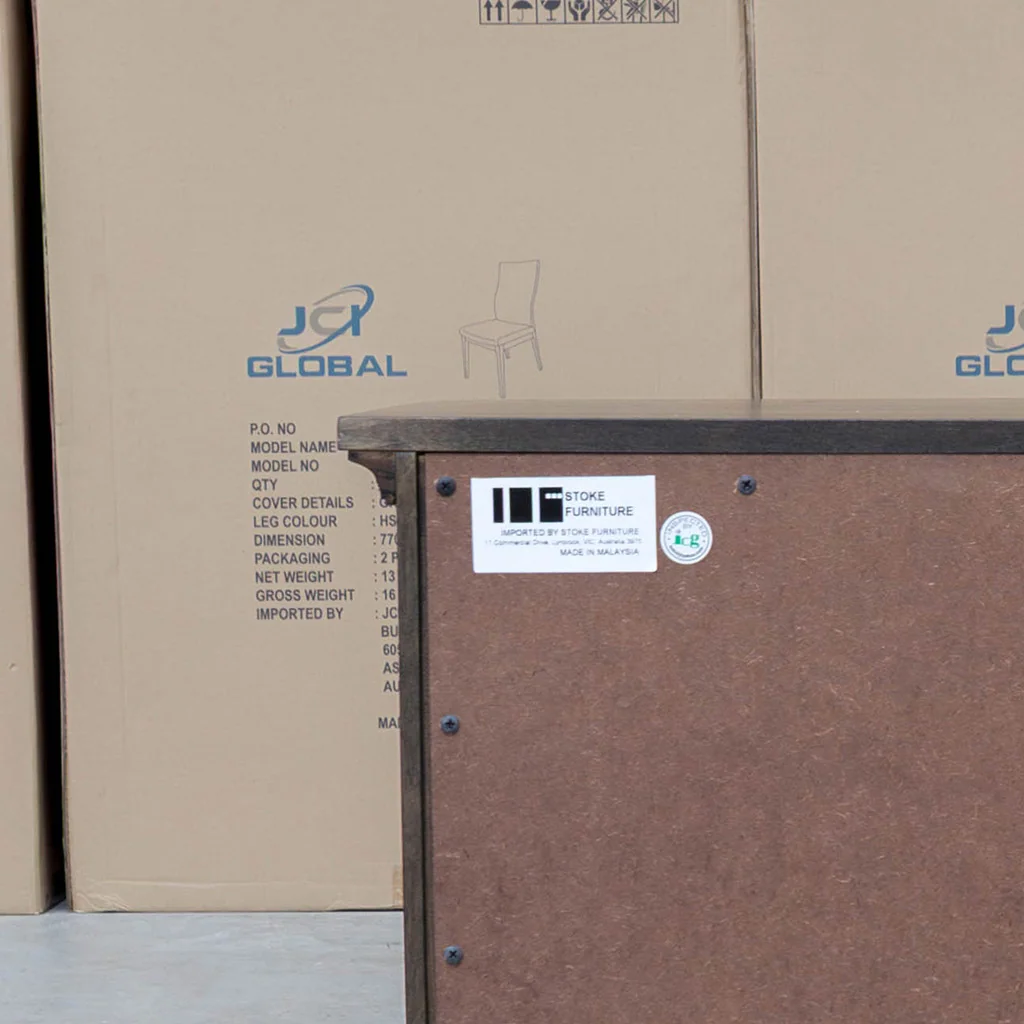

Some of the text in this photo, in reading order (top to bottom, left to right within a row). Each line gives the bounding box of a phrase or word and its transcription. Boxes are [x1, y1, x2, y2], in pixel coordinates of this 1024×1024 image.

[247, 355, 408, 378] GLOBAL
[250, 422, 296, 435] P.O. NO
[250, 441, 336, 453] MODEL NAME
[251, 459, 319, 472] MODEL NO
[252, 478, 278, 491] QTY
[565, 491, 605, 501] STOKE
[252, 497, 297, 509] COVER
[301, 497, 354, 509] DETAILS
[565, 506, 634, 517] FURNITURE
[253, 515, 279, 528] LEG
[283, 515, 337, 528] COLOUR
[561, 528, 589, 536] STOKE
[592, 528, 639, 536] FURNITURE
[254, 534, 325, 546] DIMENSION
[255, 552, 330, 564] PACKAGING
[560, 548, 639, 557] MADE IN MALAYSIA
[255, 571, 280, 583] NET
[284, 571, 334, 583] WEIGHT
[382, 571, 395, 582] 13
[256, 589, 301, 601] GROSS
[304, 589, 355, 601] WEIGHT
[382, 589, 396, 600] 16
[256, 608, 322, 620] IMPORTED
[326, 607, 344, 620] BY
